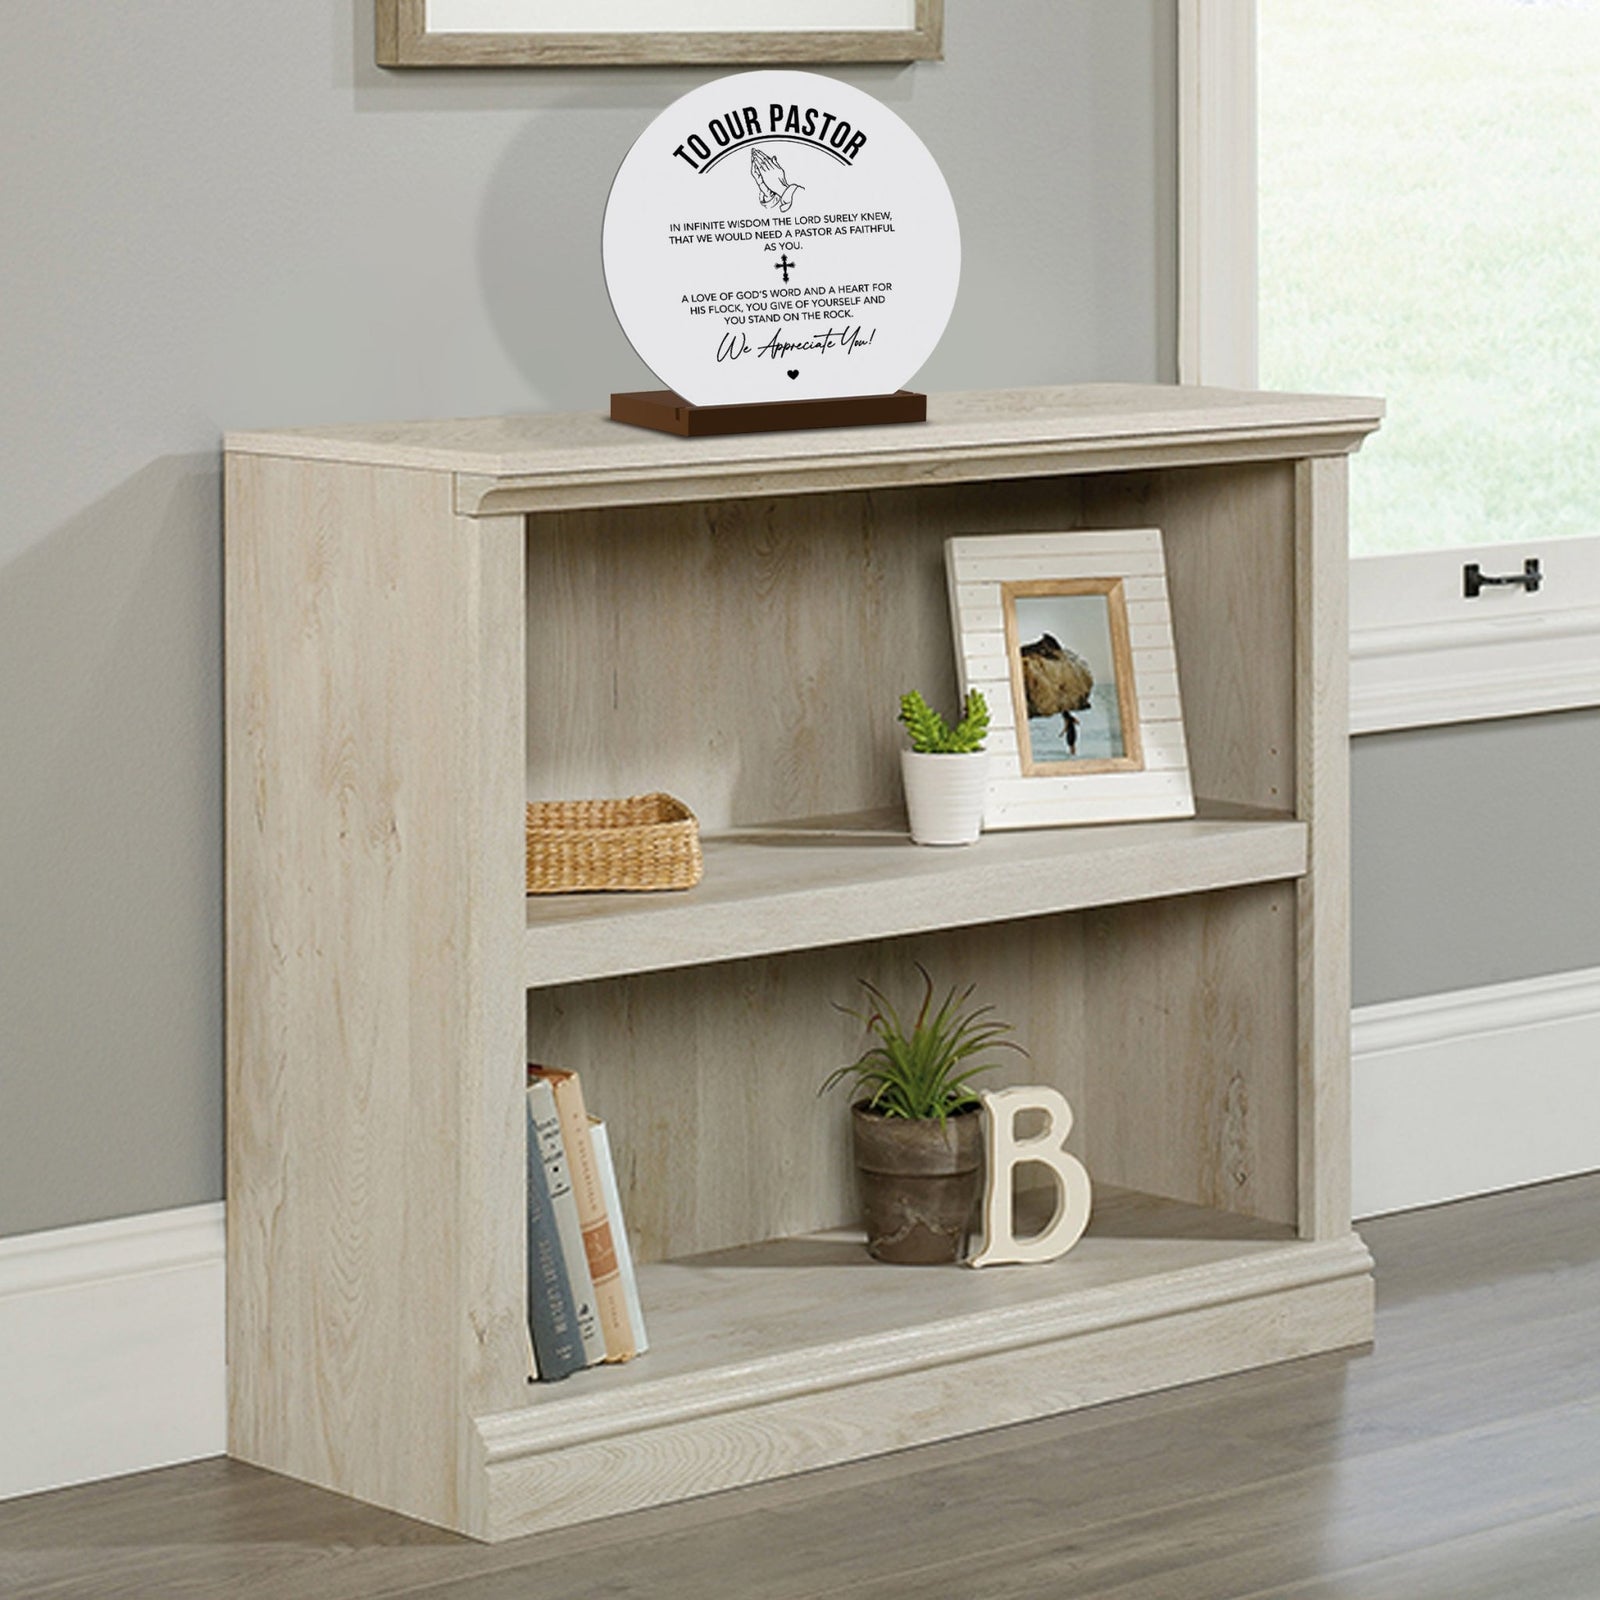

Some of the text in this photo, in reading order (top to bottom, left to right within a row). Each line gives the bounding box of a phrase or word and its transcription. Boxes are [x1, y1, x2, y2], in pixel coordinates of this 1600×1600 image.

[672, 103, 867, 170] TO OUR PASTOR
[670, 211, 892, 232] IN INFINITE WISDOM THE LORD SURELY KNEW,
[668, 224, 895, 245] THAT WE WOULD NEED A PASTOR AS FAITHFUL
[764, 241, 803, 251] AS YOU.
[681, 282, 892, 303] A LOVE OF GOD'S WORD AND A HEART FOR
[690, 295, 886, 315] HIS FLOCK, YOU GIVE OF YOURSELF AND
[724, 309, 854, 325] YOU STAND ON THE ROCK.
[716, 324, 877, 363] We Appreciate You!
[966, 1085, 1092, 1268] B
